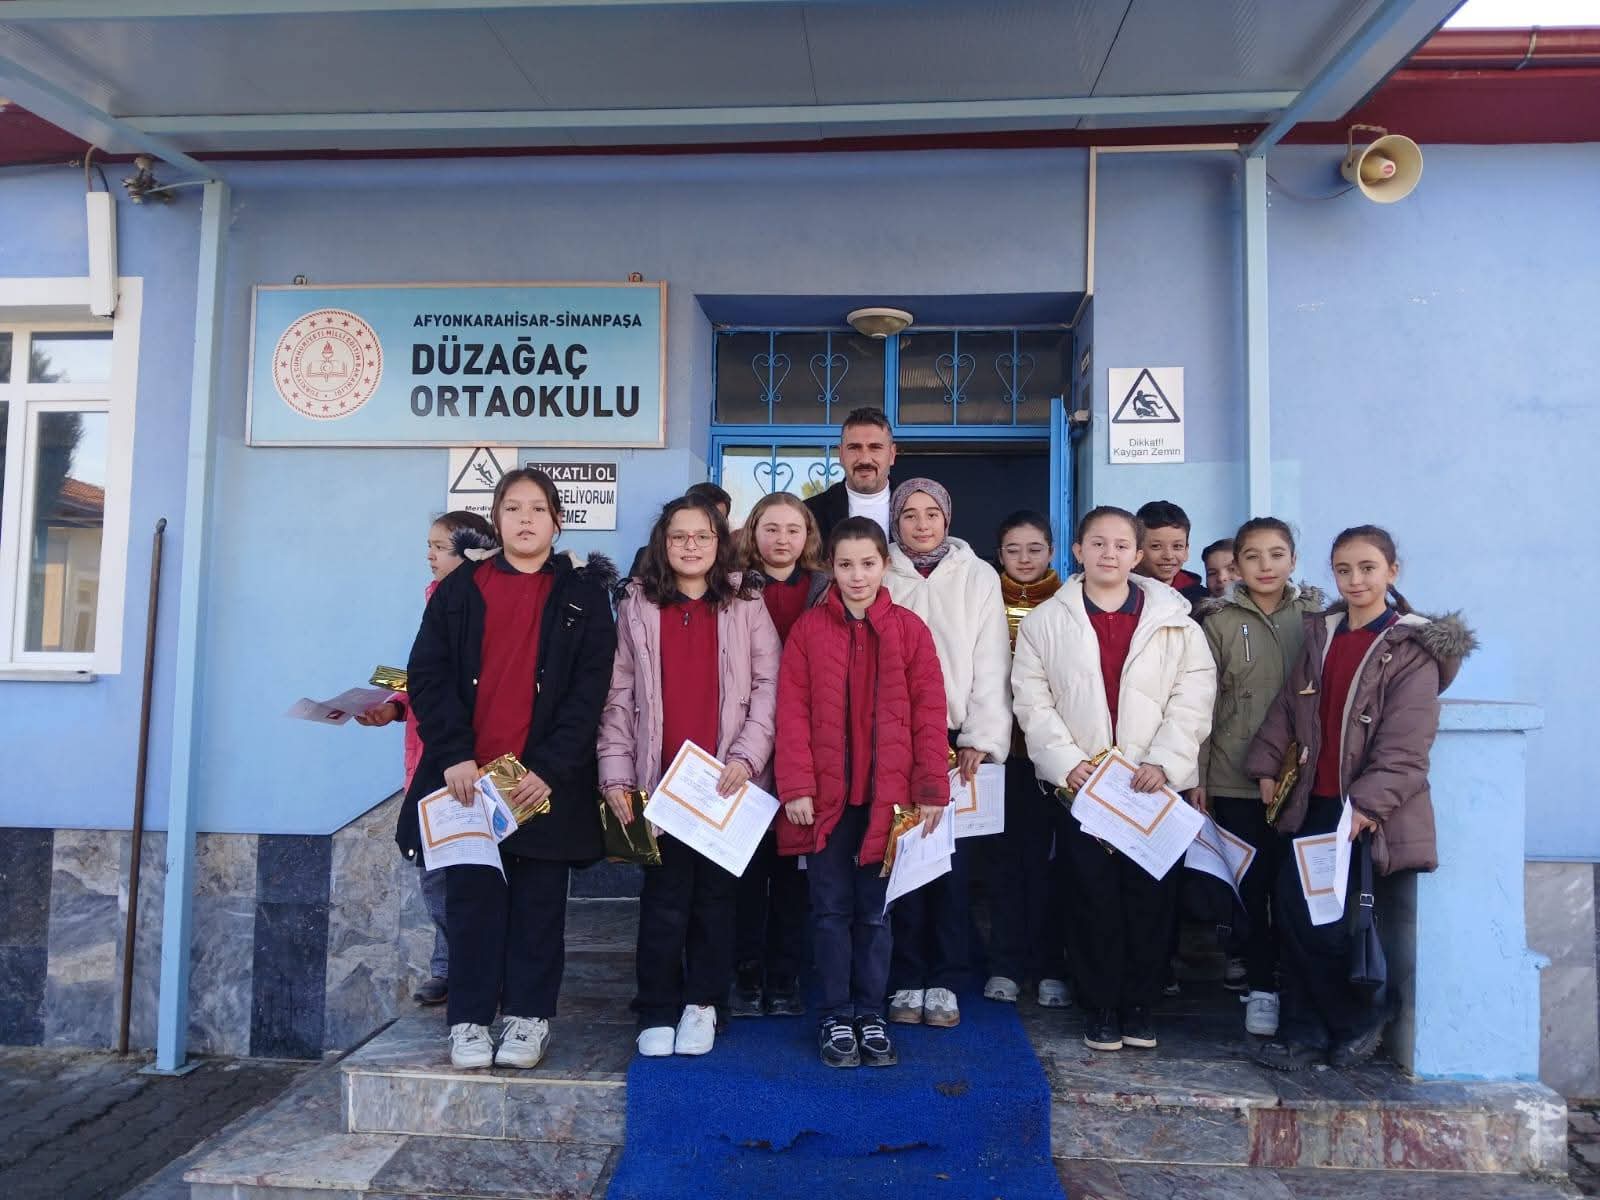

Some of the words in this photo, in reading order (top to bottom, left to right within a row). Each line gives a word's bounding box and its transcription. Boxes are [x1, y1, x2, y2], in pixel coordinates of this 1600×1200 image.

[413, 311, 642, 328] AFYONKARAHİSAR-SİNANPAŞA
[412, 334, 588, 380] DÜZAĞAÇ
[410, 385, 640, 417] ORTAOKULU
[1113, 447, 1149, 458] Kaygan
[1151, 447, 1181, 456] Zemin
[528, 464, 592, 480] İKKATLİ
[595, 466, 615, 480] OL
[561, 509, 587, 523] EMEZ
